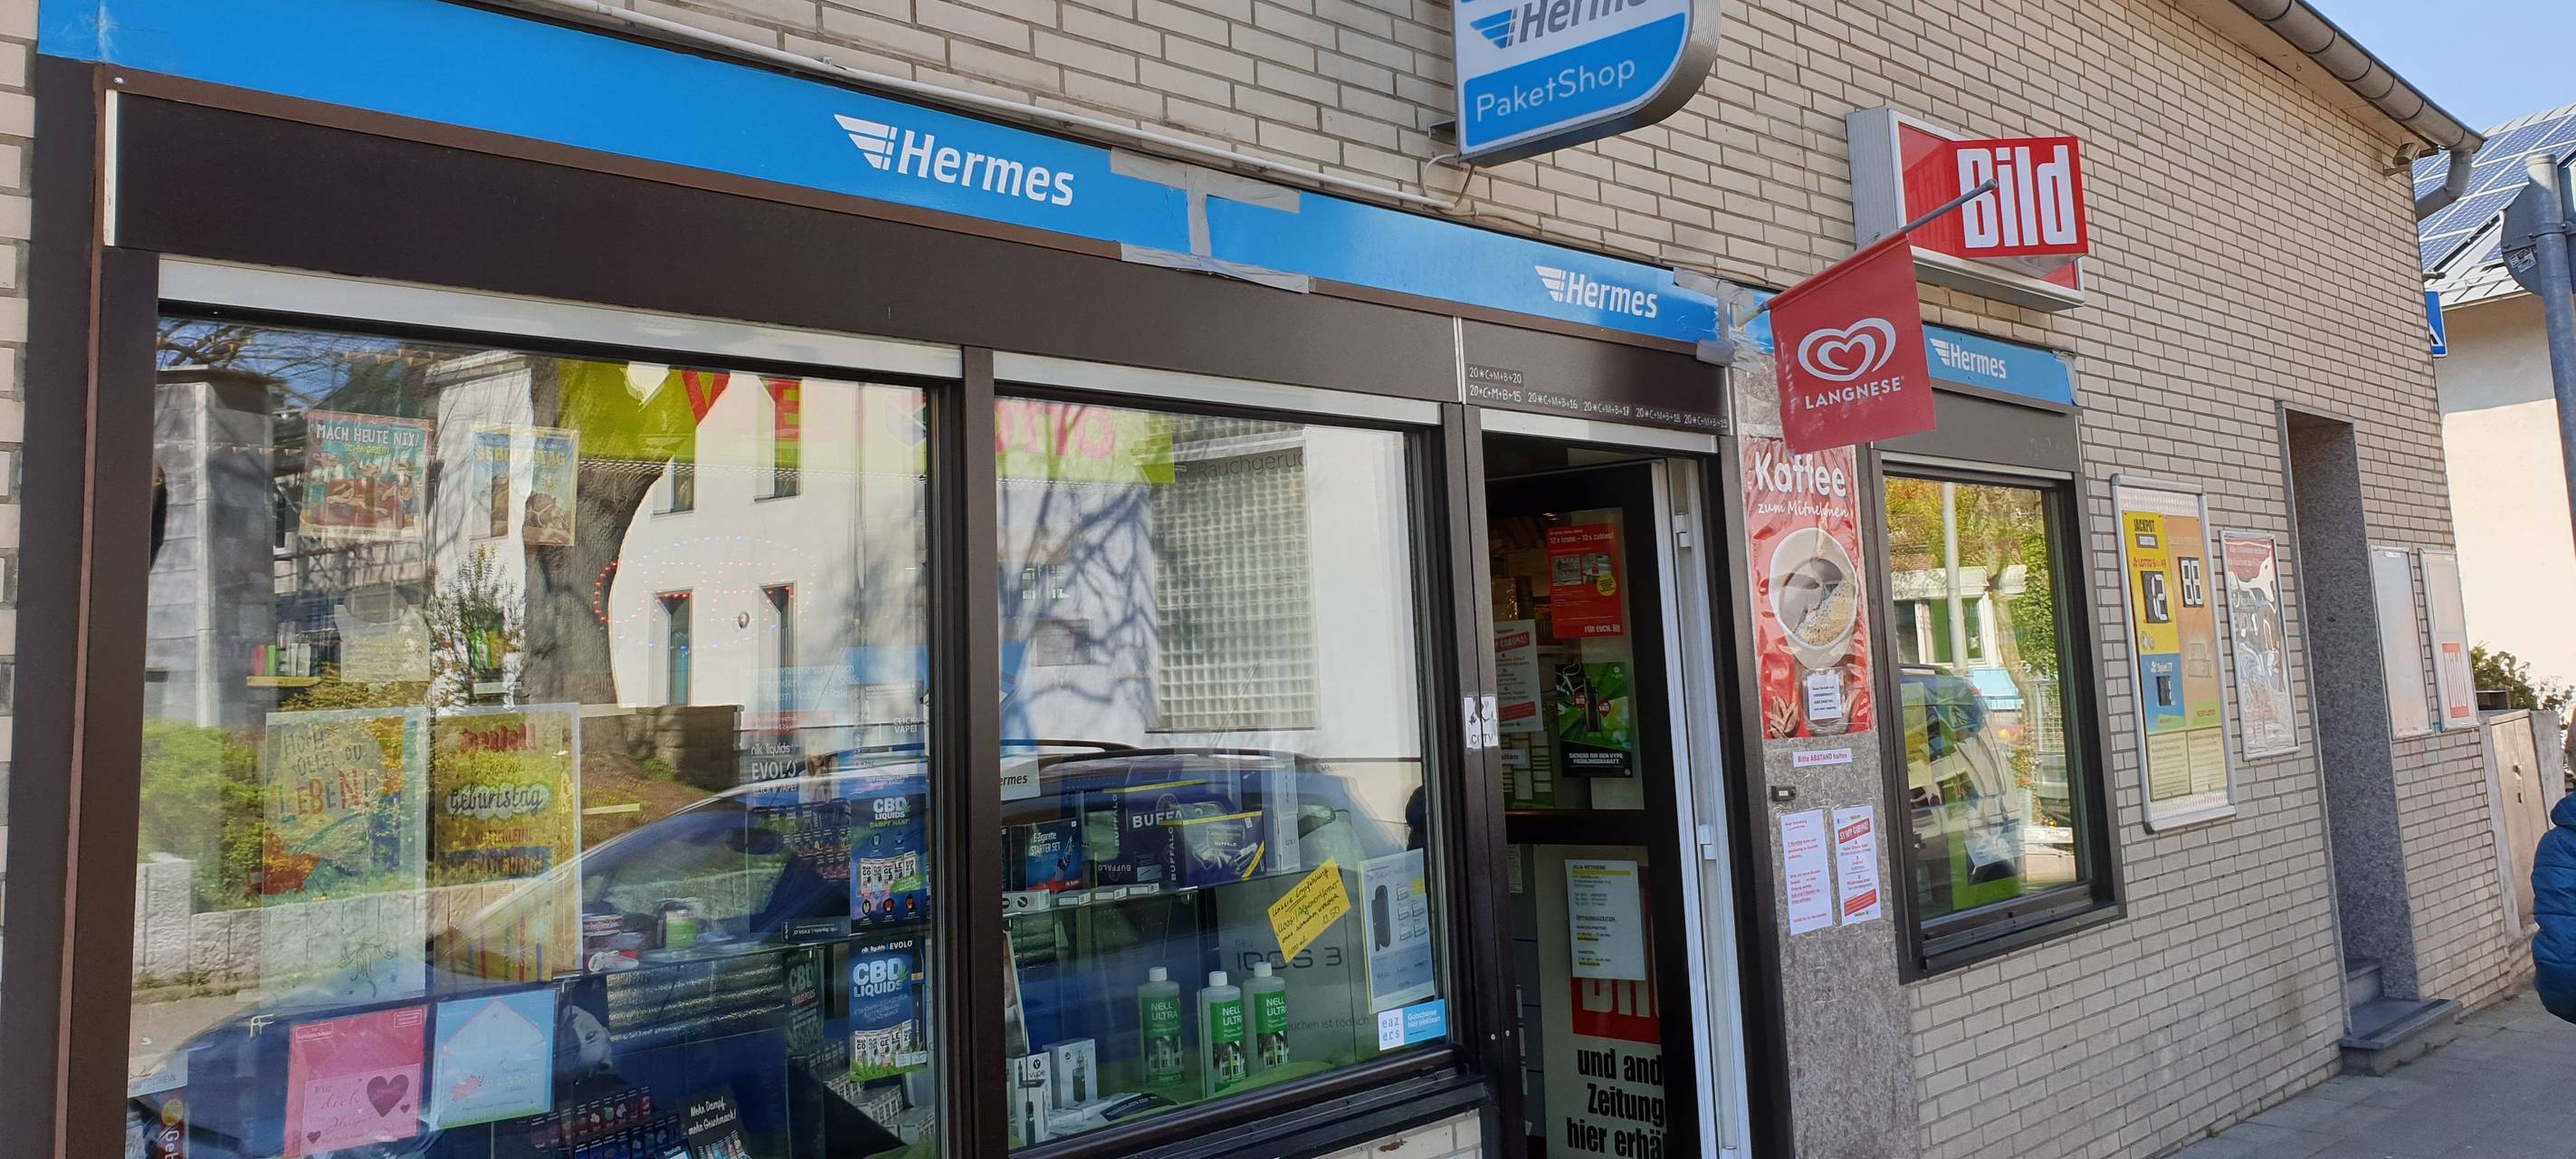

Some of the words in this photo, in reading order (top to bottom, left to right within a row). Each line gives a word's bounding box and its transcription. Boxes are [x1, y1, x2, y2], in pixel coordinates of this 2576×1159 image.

[1476, 59, 1636, 122] PaketShop
[897, 129, 1075, 207] Hermes
[1956, 144, 2078, 249] Bild
[1566, 271, 1659, 319] Hermes
[1951, 343, 2007, 379] Hermes
[1805, 378, 1902, 409] LANGNESE
[317, 422, 349, 443] MACH
[354, 425, 389, 445] HEUTE
[1754, 451, 1846, 497] Kaffee
[1758, 503, 1787, 514] zum
[2133, 519, 2155, 533] JACKPOT
[1471, 733, 1493, 744] CTV
[1810, 752, 1833, 762] ABSTAND
[999, 773, 1028, 786] ermes
[873, 796, 907, 813] CBD
[874, 811, 905, 821] LIQUIDS
[1168, 825, 1177, 882] BUFFALO
[889, 940, 913, 951] EVOLO
[1324, 946, 1342, 967] 3
[788, 963, 814, 994] CBD
[853, 957, 905, 986] CBD
[854, 980, 903, 999] LIQUIDS
[1151, 1000, 1174, 1011] NELL
[1222, 1006, 1241, 1016] NELL
[1266, 996, 1285, 1007] NELL
[1150, 1010, 1178, 1021] ULTRA
[1577, 1048, 1617, 1080] und
[690, 1102, 706, 1117] Mehr
[1566, 1116, 1608, 1154] hier
